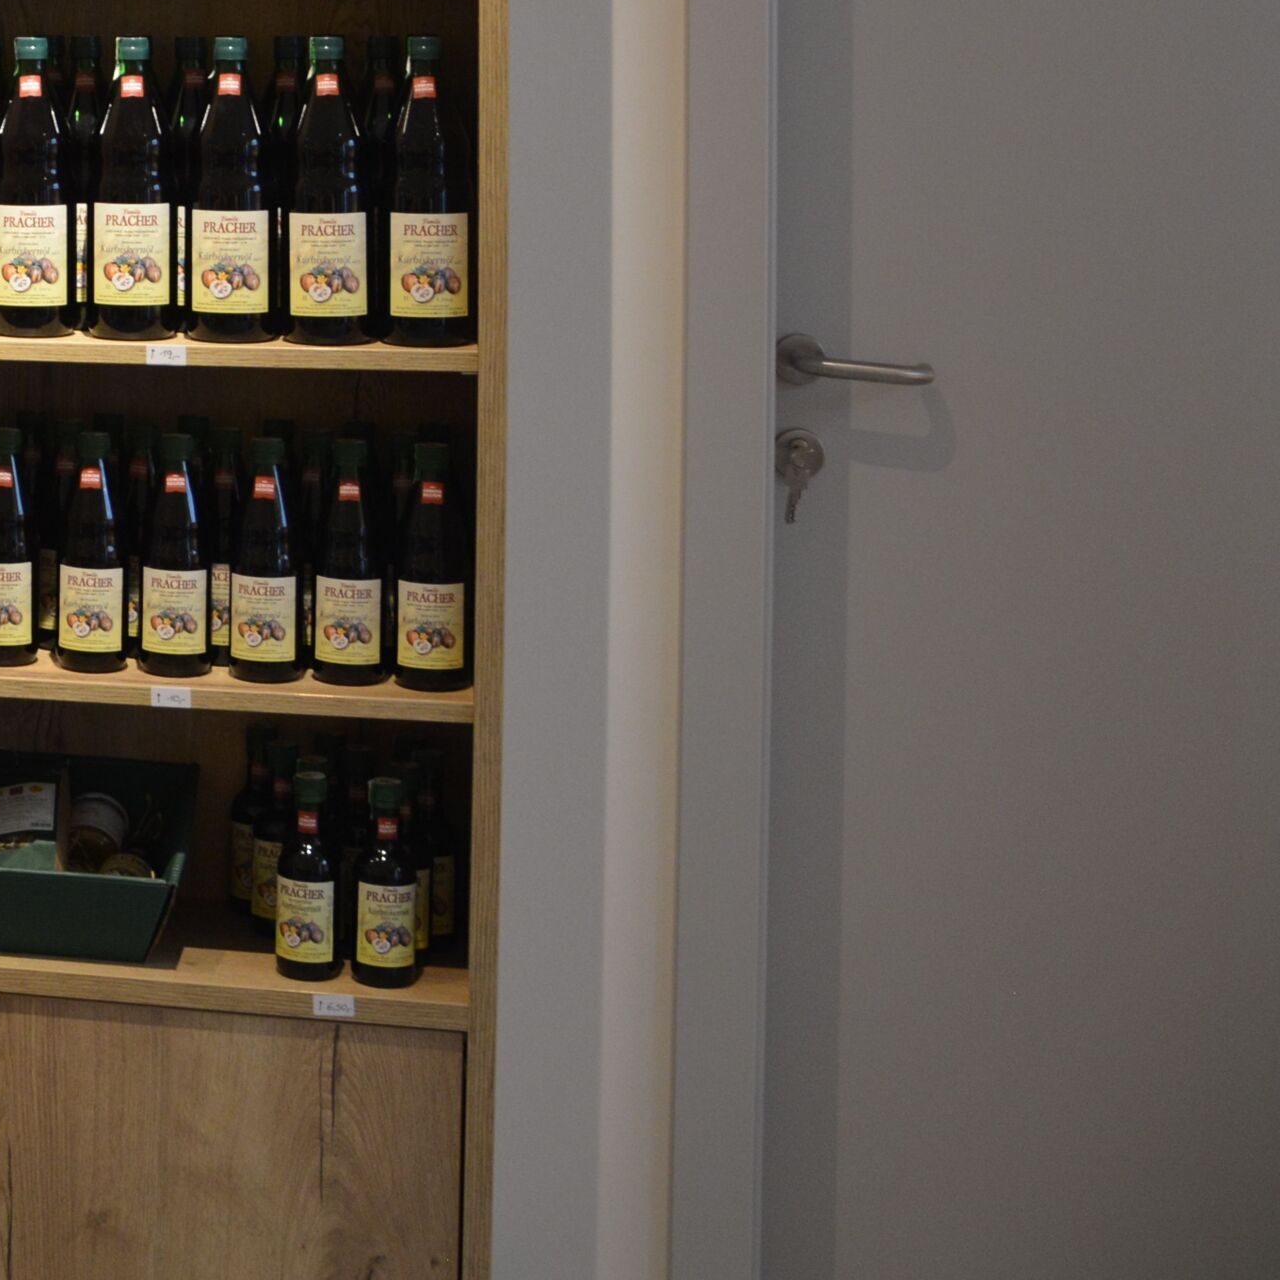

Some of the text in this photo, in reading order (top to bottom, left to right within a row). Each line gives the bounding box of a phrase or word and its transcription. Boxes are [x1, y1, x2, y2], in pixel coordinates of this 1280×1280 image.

[3, 216, 55, 228] PRACHER
[105, 214, 158, 226] PRACHER
[203, 221, 257, 233] PRACHER
[301, 224, 355, 236] PRACHER
[403, 224, 458, 236] PRACHER
[67, 575, 113, 588] PRACHER
[151, 577, 198, 589] PRACHER
[238, 583, 286, 597] PRACHER
[324, 587, 373, 600] PRACHER
[406, 591, 456, 604] PRACHER
[279, 884, 325, 900] PRACHER
[366, 890, 412, 903] PRACHER
